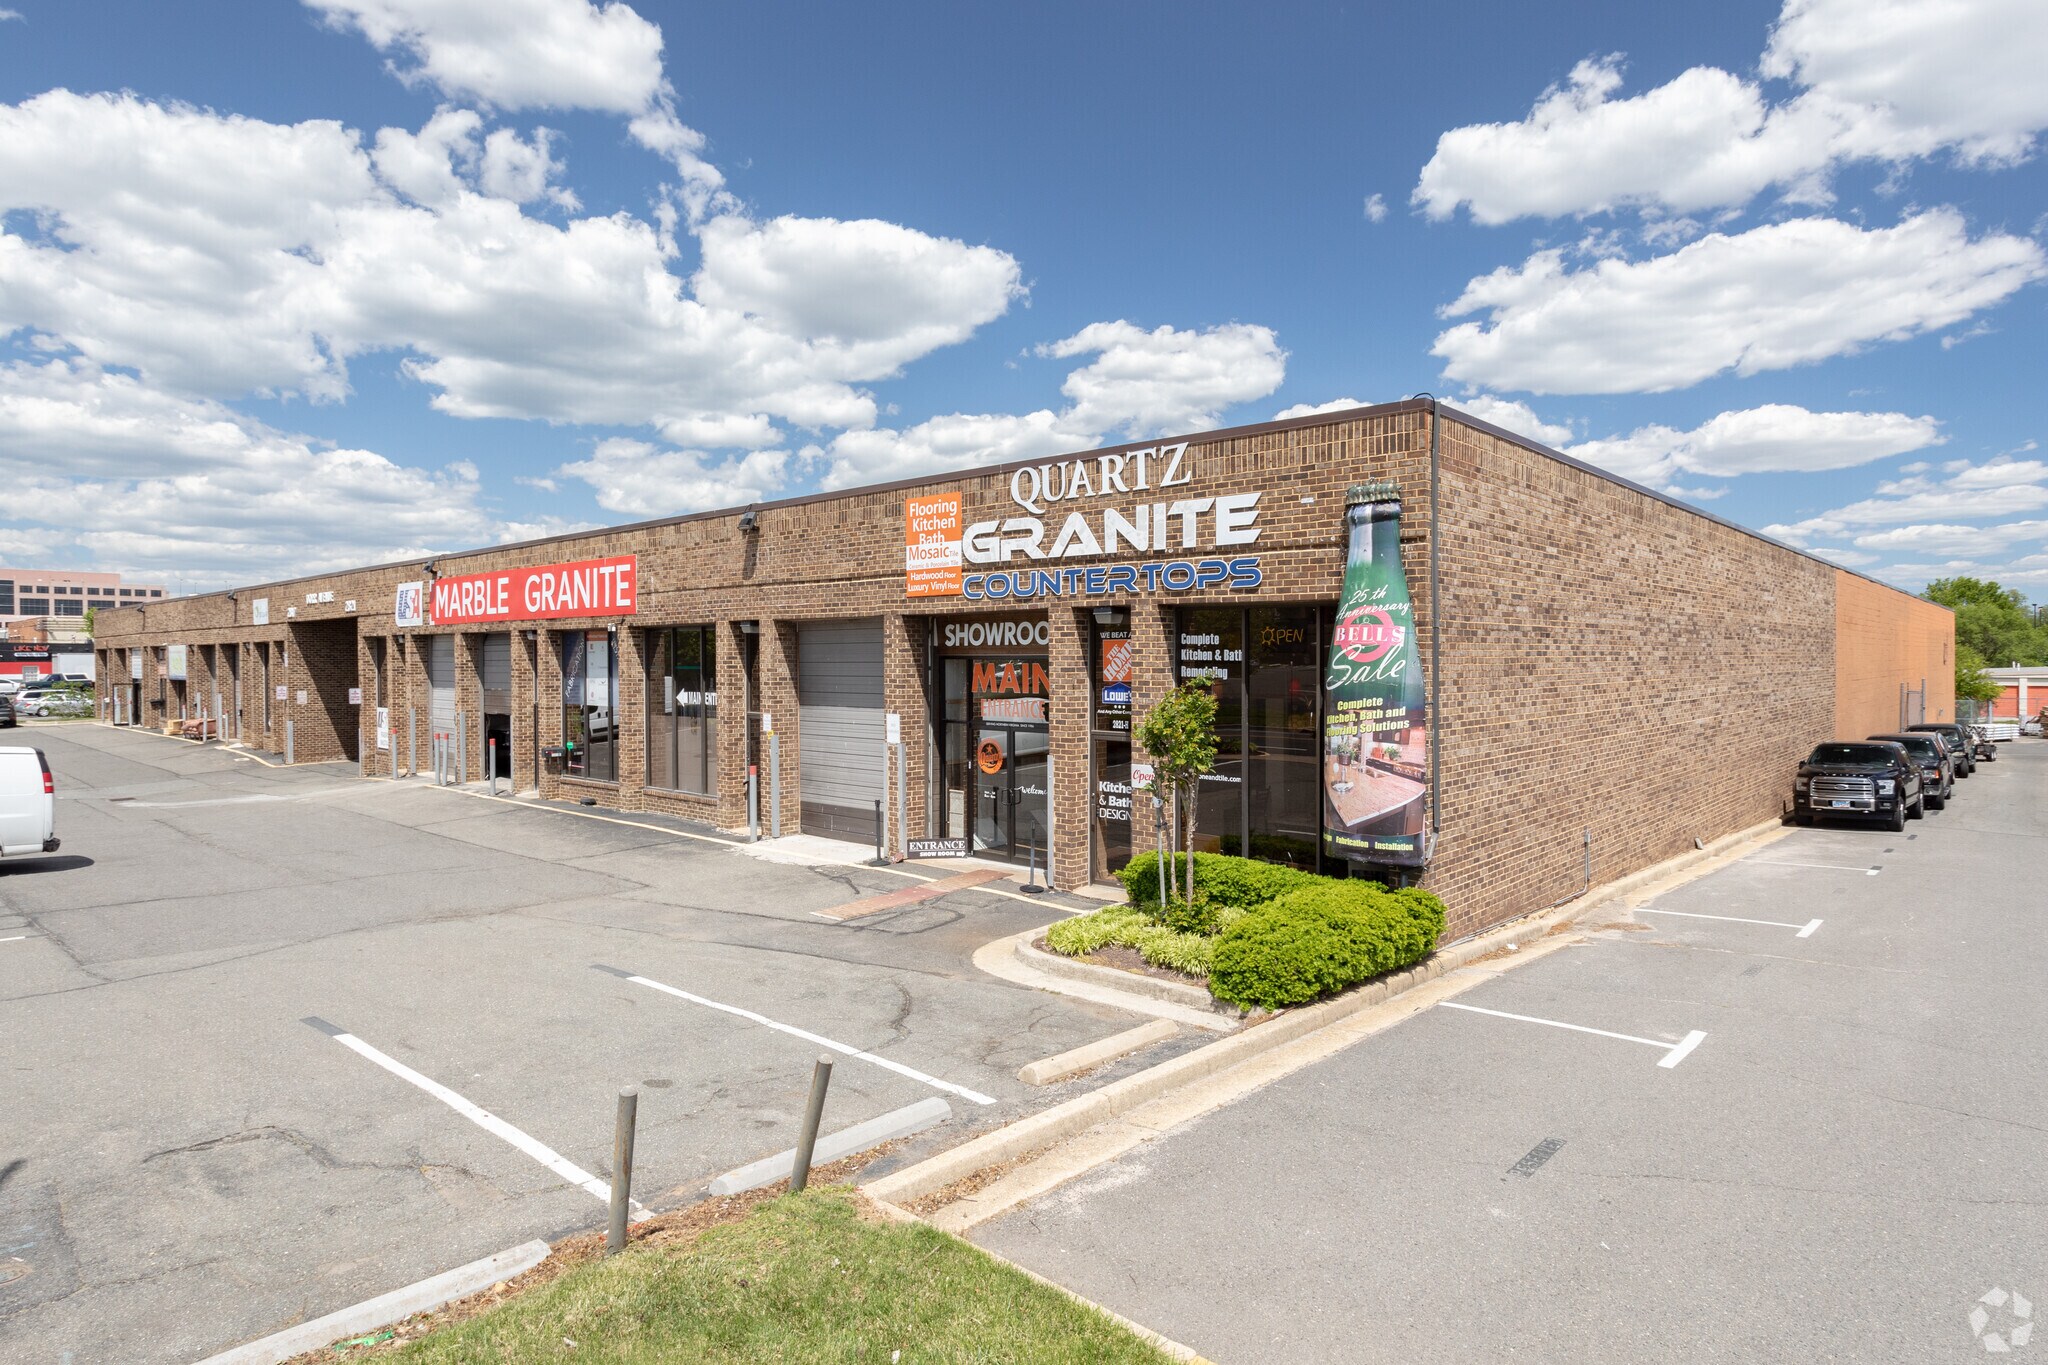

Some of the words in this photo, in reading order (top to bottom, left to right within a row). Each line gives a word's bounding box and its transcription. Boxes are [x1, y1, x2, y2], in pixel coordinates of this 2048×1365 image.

[1011, 442, 1191, 514] QUARTZ
[910, 499, 957, 517] Flooring
[913, 515, 956, 532] Kitchen
[962, 492, 1262, 563] GRANITE
[919, 530, 945, 544] Bath
[909, 543, 949, 560] Mosaic
[911, 570, 944, 580] Hardwood
[962, 557, 1262, 599] COUNTERTOPS
[435, 577, 509, 618] MARBLE
[525, 564, 631, 613] GRANITE
[908, 583, 929, 593] Luxury
[930, 580, 947, 592] Vinyl
[1349, 588, 1370, 605] 25
[1369, 584, 1388, 601] th
[1336, 602, 1410, 621] Anniversary
[1181, 633, 1219, 646] Complete
[1336, 626, 1405, 643] BELLS
[1106, 644, 1121, 661] THE
[1181, 650, 1213, 661] Kitchen
[1215, 650, 1221, 661] &
[1224, 649, 1242, 661] Bath
[565, 638, 585, 698] FABRICATION
[1181, 665, 1228, 680] Remodeling
[1326, 643, 1406, 690] Sale
[972, 663, 1049, 694] MAIN
[981, 699, 1045, 719] ENTRANCE
[1337, 697, 1383, 711] Complete
[1327, 713, 1358, 725] Kitchen,
[1360, 709, 1383, 721] Bath
[1386, 706, 1406, 718] and
[1326, 726, 1358, 737] Flooring
[1360, 720, 1410, 733] Solutions
[1132, 769, 1155, 783] Open
[1099, 794, 1106, 805] &
[1108, 795, 1132, 808] Bath
[1099, 808, 1132, 821] DESIGN
[909, 840, 965, 850] ENTRANCE
[1336, 836, 1369, 849] Fabrication
[1374, 841, 1413, 851] Installation
